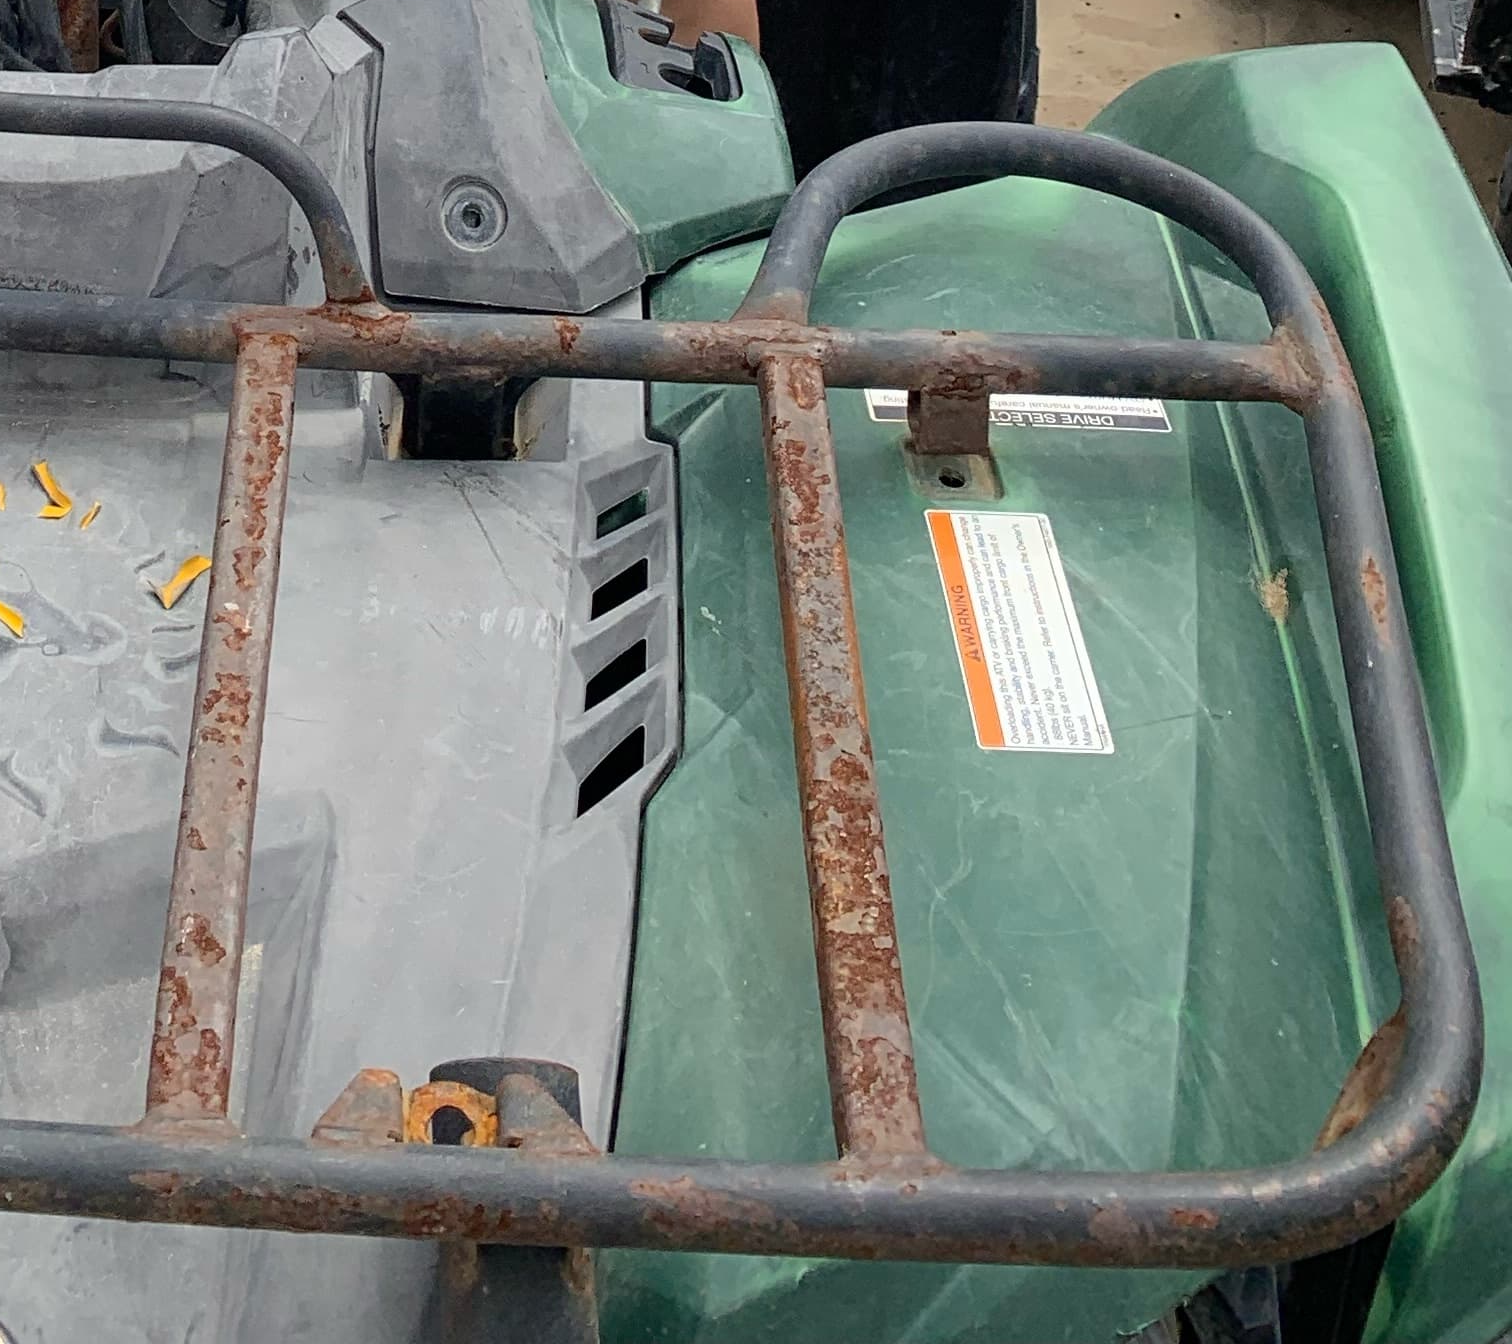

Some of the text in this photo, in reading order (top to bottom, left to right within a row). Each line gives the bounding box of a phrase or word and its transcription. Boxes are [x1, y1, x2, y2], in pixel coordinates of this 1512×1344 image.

[988, 400, 1150, 414] Read owner's manual carefu
[1061, 413, 1114, 426] DRIVE
[957, 516, 972, 541] change
[1009, 523, 1026, 551] Owner's
[964, 542, 975, 555] can
[974, 532, 986, 547] lead
[989, 542, 1002, 557] limit
[979, 548, 989, 561] can
[1018, 551, 1029, 563] the
[967, 556, 986, 593] improperly
[982, 563, 993, 577] and
[994, 558, 1009, 578] cargo
[998, 579, 1012, 596] front
[1024, 573, 1044, 615] instructions
[977, 595, 992, 616] cargo
[985, 578, 1007, 625] performance
[949, 584, 977, 647] WARNING
[1004, 598, 1022, 635] maximum
[983, 618, 1000, 649] carrying
[998, 626, 1015, 655] braking
[1014, 636, 1026, 649] the
[1037, 625, 1052, 646] Refer
[991, 660, 1005, 676] ATV
[1005, 657, 1018, 672] and
[1017, 650, 1034, 679] exceed
[996, 678, 1009, 693] this
[1009, 673, 1027, 704] stability
[1025, 681, 1040, 705] Never
[1051, 676, 1064, 689] the
[1000, 694, 1023, 744] Overloading
[1044, 702, 1059, 716] (40
[1061, 715, 1079, 745] NEVER
[1075, 713, 1094, 746] Manual.
